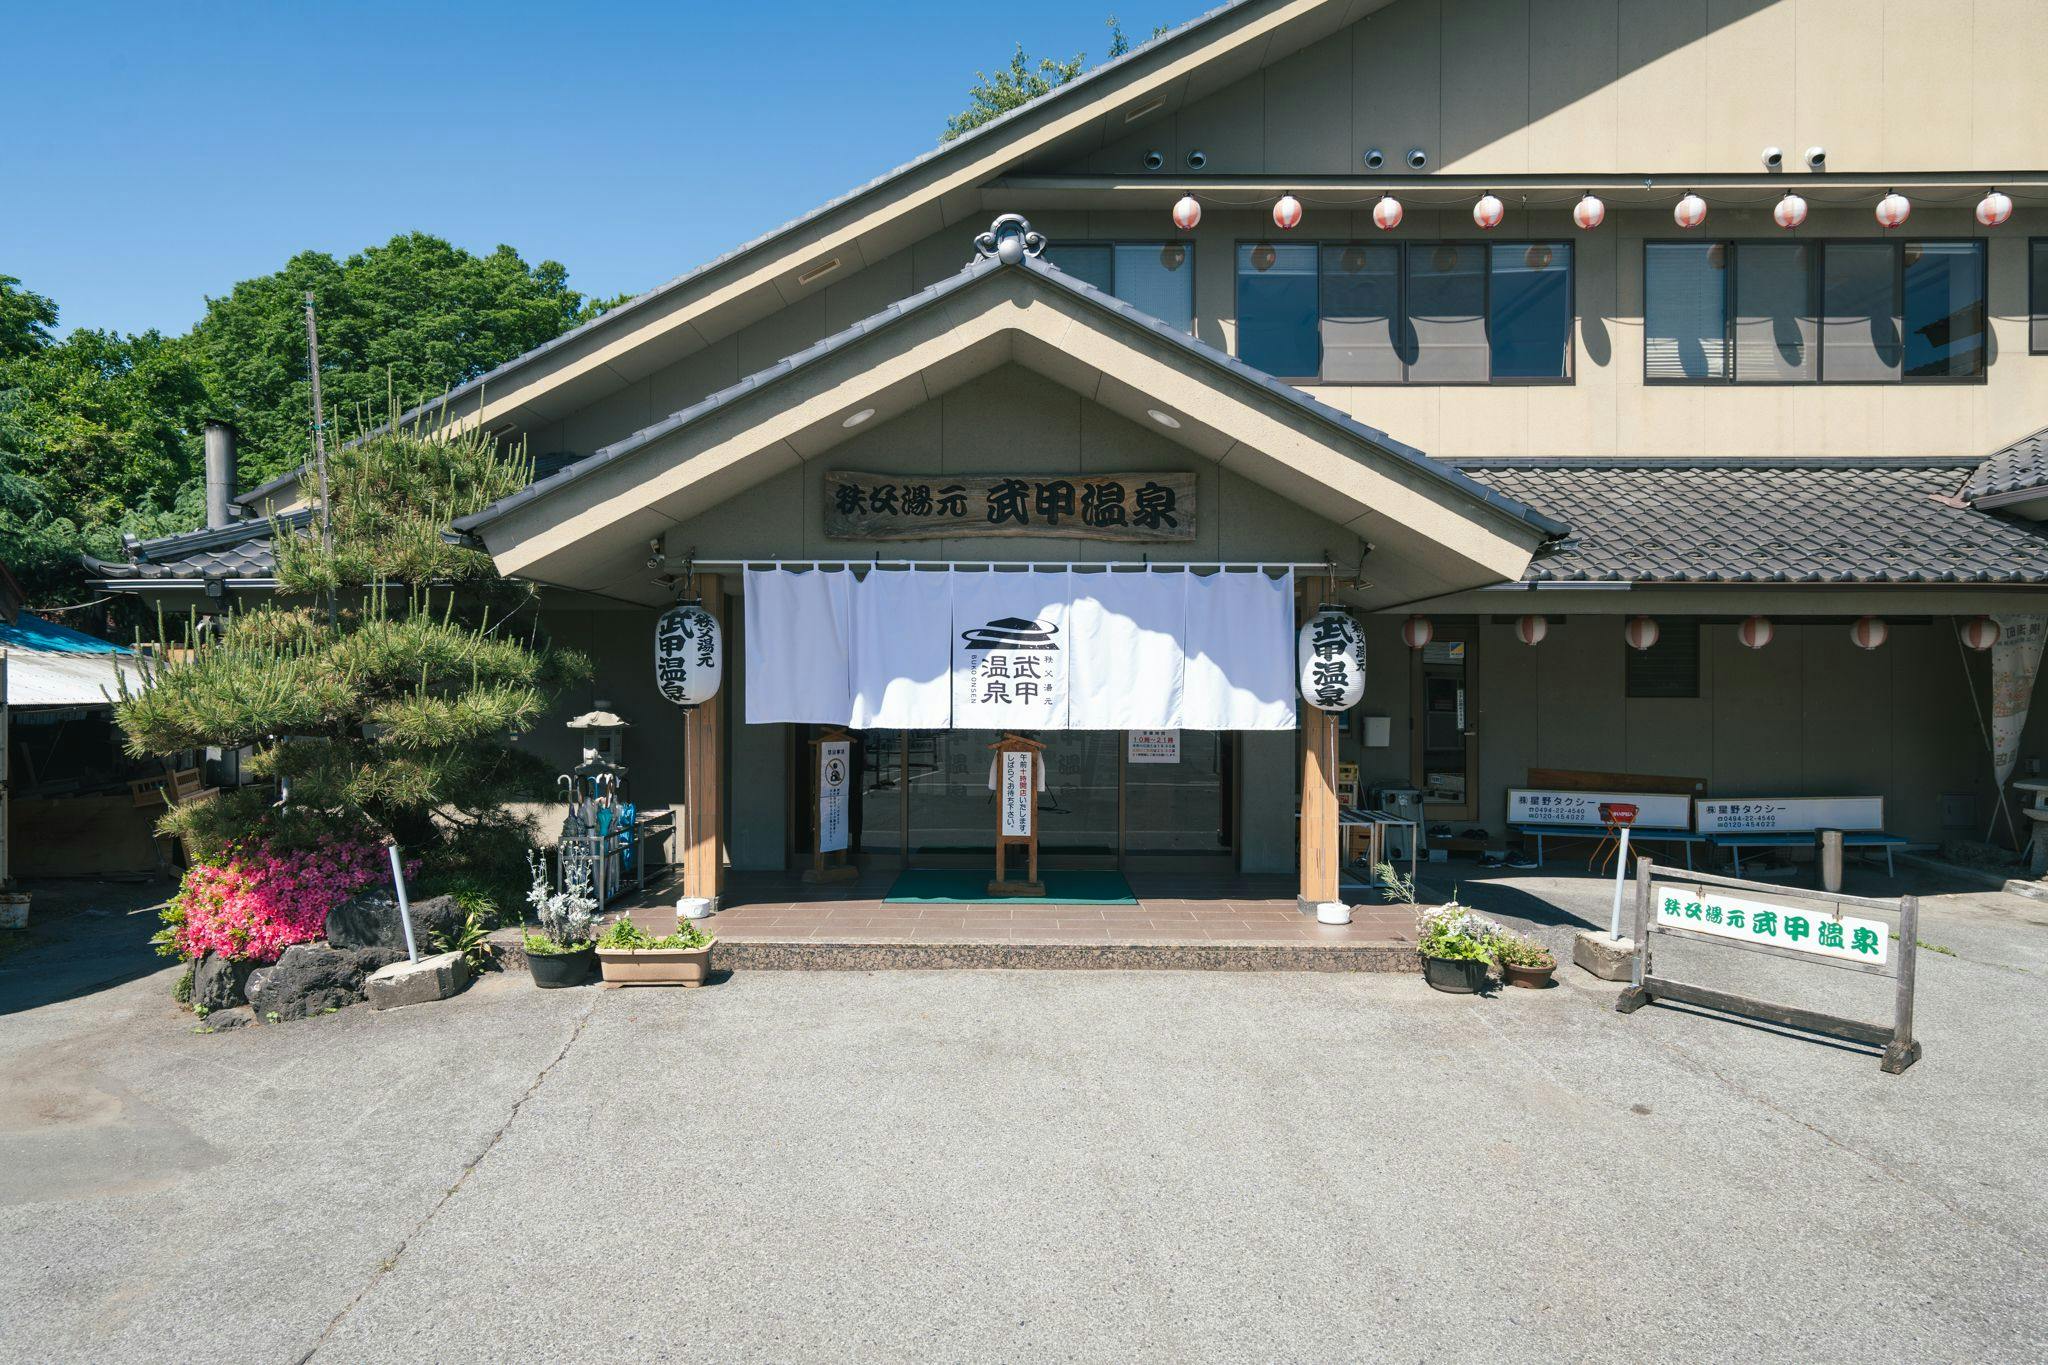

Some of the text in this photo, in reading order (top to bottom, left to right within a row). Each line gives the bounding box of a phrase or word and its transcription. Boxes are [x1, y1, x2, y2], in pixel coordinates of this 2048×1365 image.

[834, 478, 1178, 529] 秩父湯元 武甲温泉
[658, 609, 696, 701] 武甲温泉
[694, 613, 715, 668] 秩父湯元
[1312, 616, 1354, 706] 武甲温泉
[1043, 655, 1054, 705] 秩父湯元
[1007, 754, 1015, 828] しばらくお待ち下さい。
[1019, 753, 1028, 834] 午前十時開店いたします。
[1535, 813, 1585, 821] 0120-454022
[1664, 897, 1880, 956] 秩父湯元 武甲温泉
